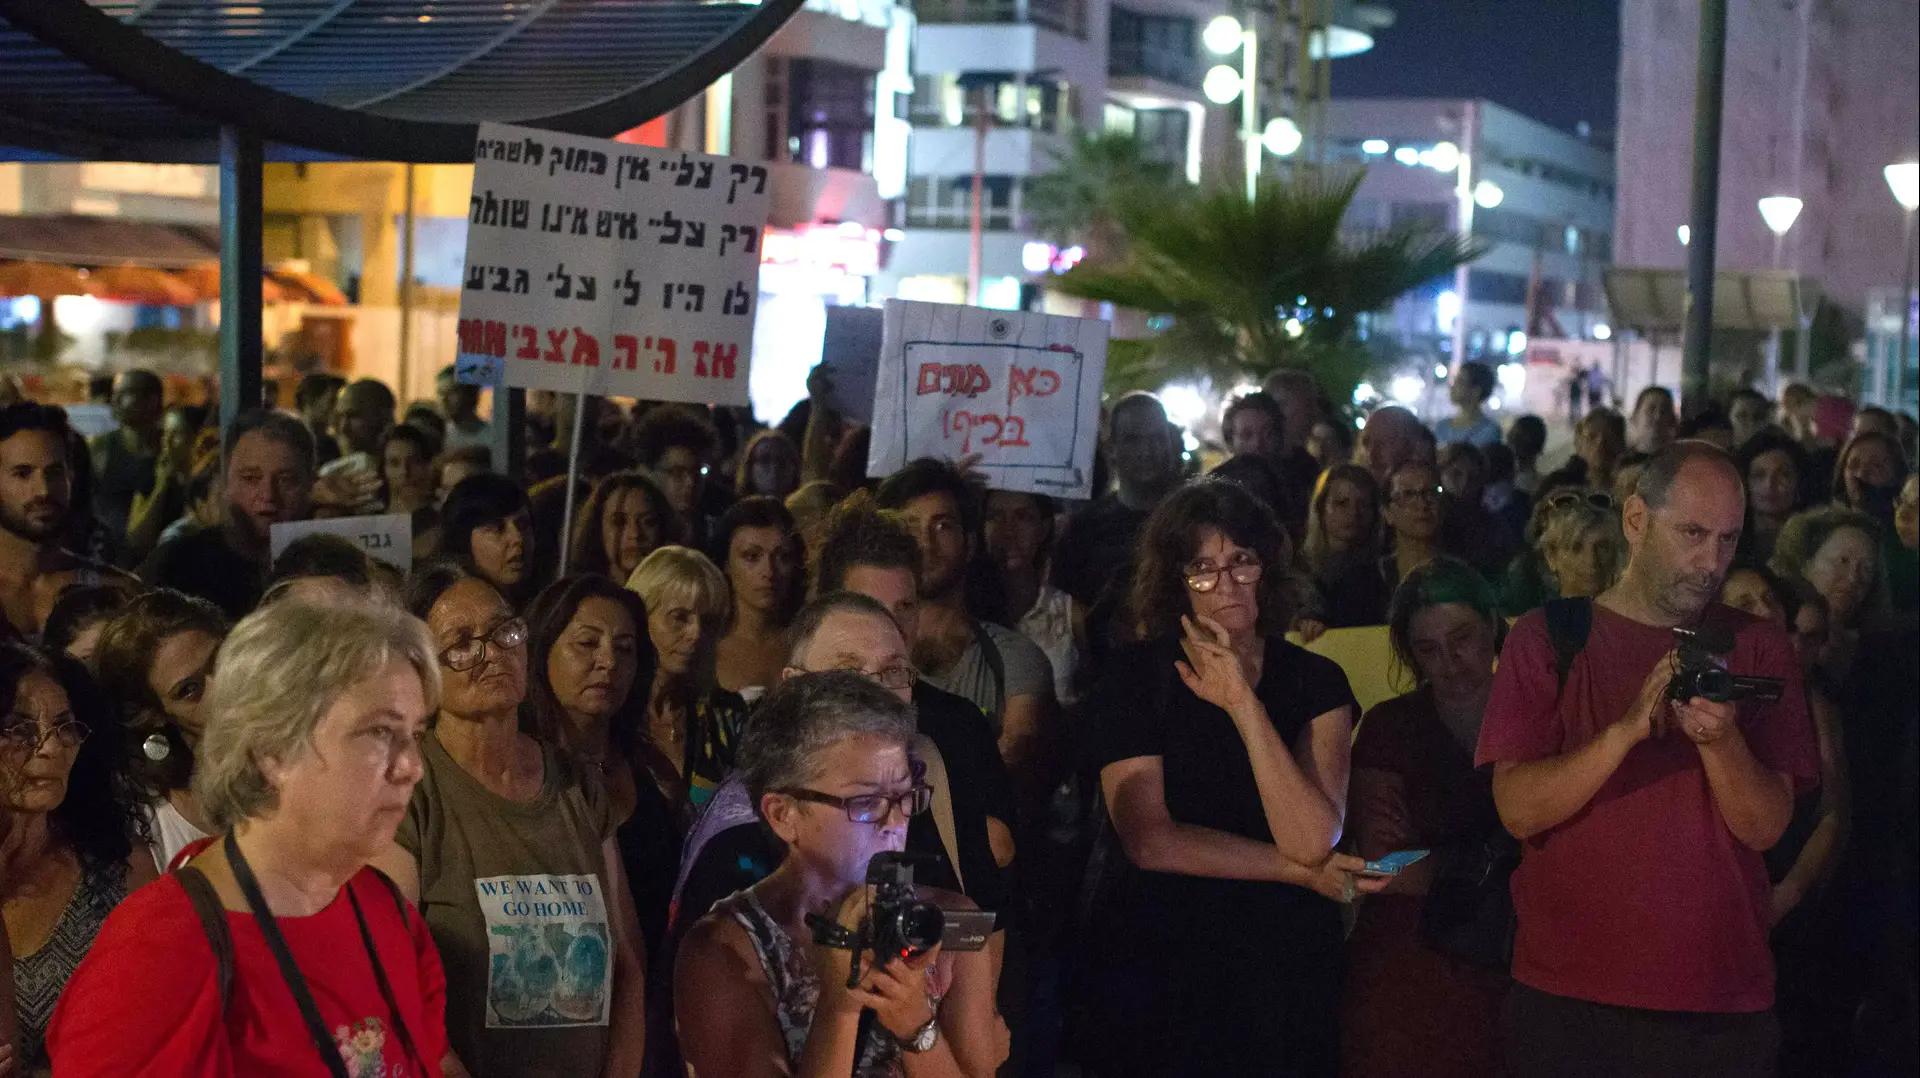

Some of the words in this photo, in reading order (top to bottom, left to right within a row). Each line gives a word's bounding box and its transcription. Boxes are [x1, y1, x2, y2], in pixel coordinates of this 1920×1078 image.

[614, 155, 650, 190] אין
[727, 163, 768, 204] רק
[470, 189, 530, 229] שומר
[541, 203, 589, 236] אינו
[596, 209, 639, 241] איש
[719, 223, 758, 256] רק
[466, 265, 530, 295] גביע
[613, 269, 641, 306] לי
[662, 282, 705, 312] היו
[722, 281, 751, 315] לו
[511, 326, 600, 367] מצבי
[612, 334, 677, 374] היה
[692, 339, 739, 379] אז
[480, 880, 514, 896] WE
[516, 880, 568, 896] WANT
[571, 881, 593, 896] TO
[503, 901, 530, 917] GO
[533, 901, 589, 917] HOME
